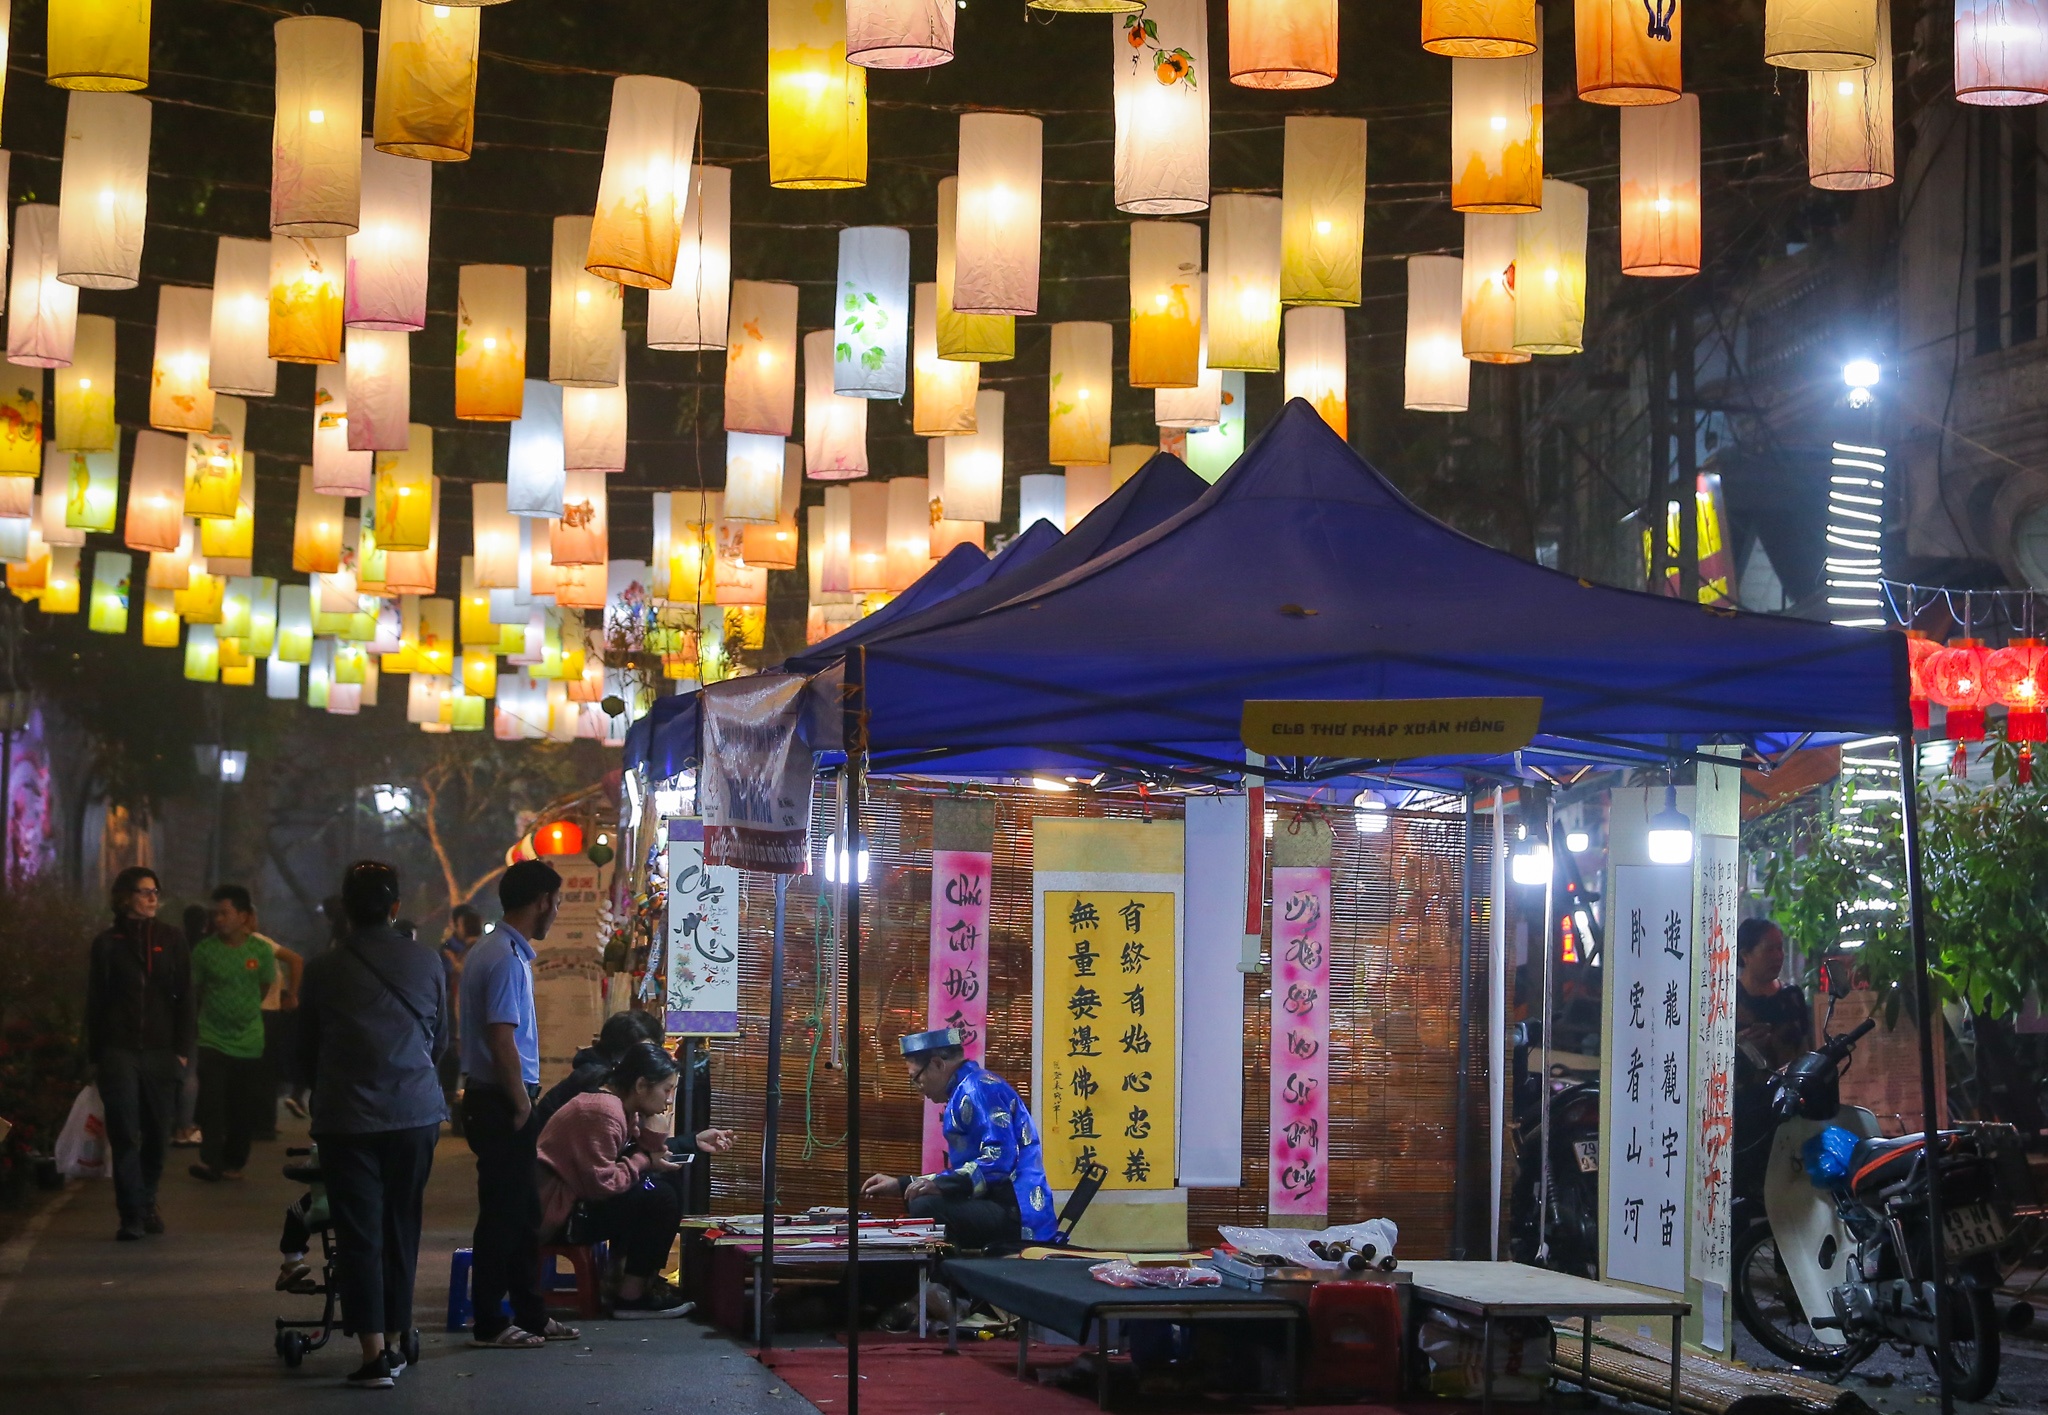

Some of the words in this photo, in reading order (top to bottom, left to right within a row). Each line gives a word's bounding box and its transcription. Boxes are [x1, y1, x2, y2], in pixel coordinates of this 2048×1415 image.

[1271, 722, 1305, 736] CLB
[1311, 721, 1348, 736] THƯ
[1352, 720, 1399, 737] PHÁP
[1403, 719, 1451, 736] XUÂN
[945, 872, 982, 907] Chúc
[946, 919, 983, 952] Tết
[1282, 1072, 1318, 1106] Sự
